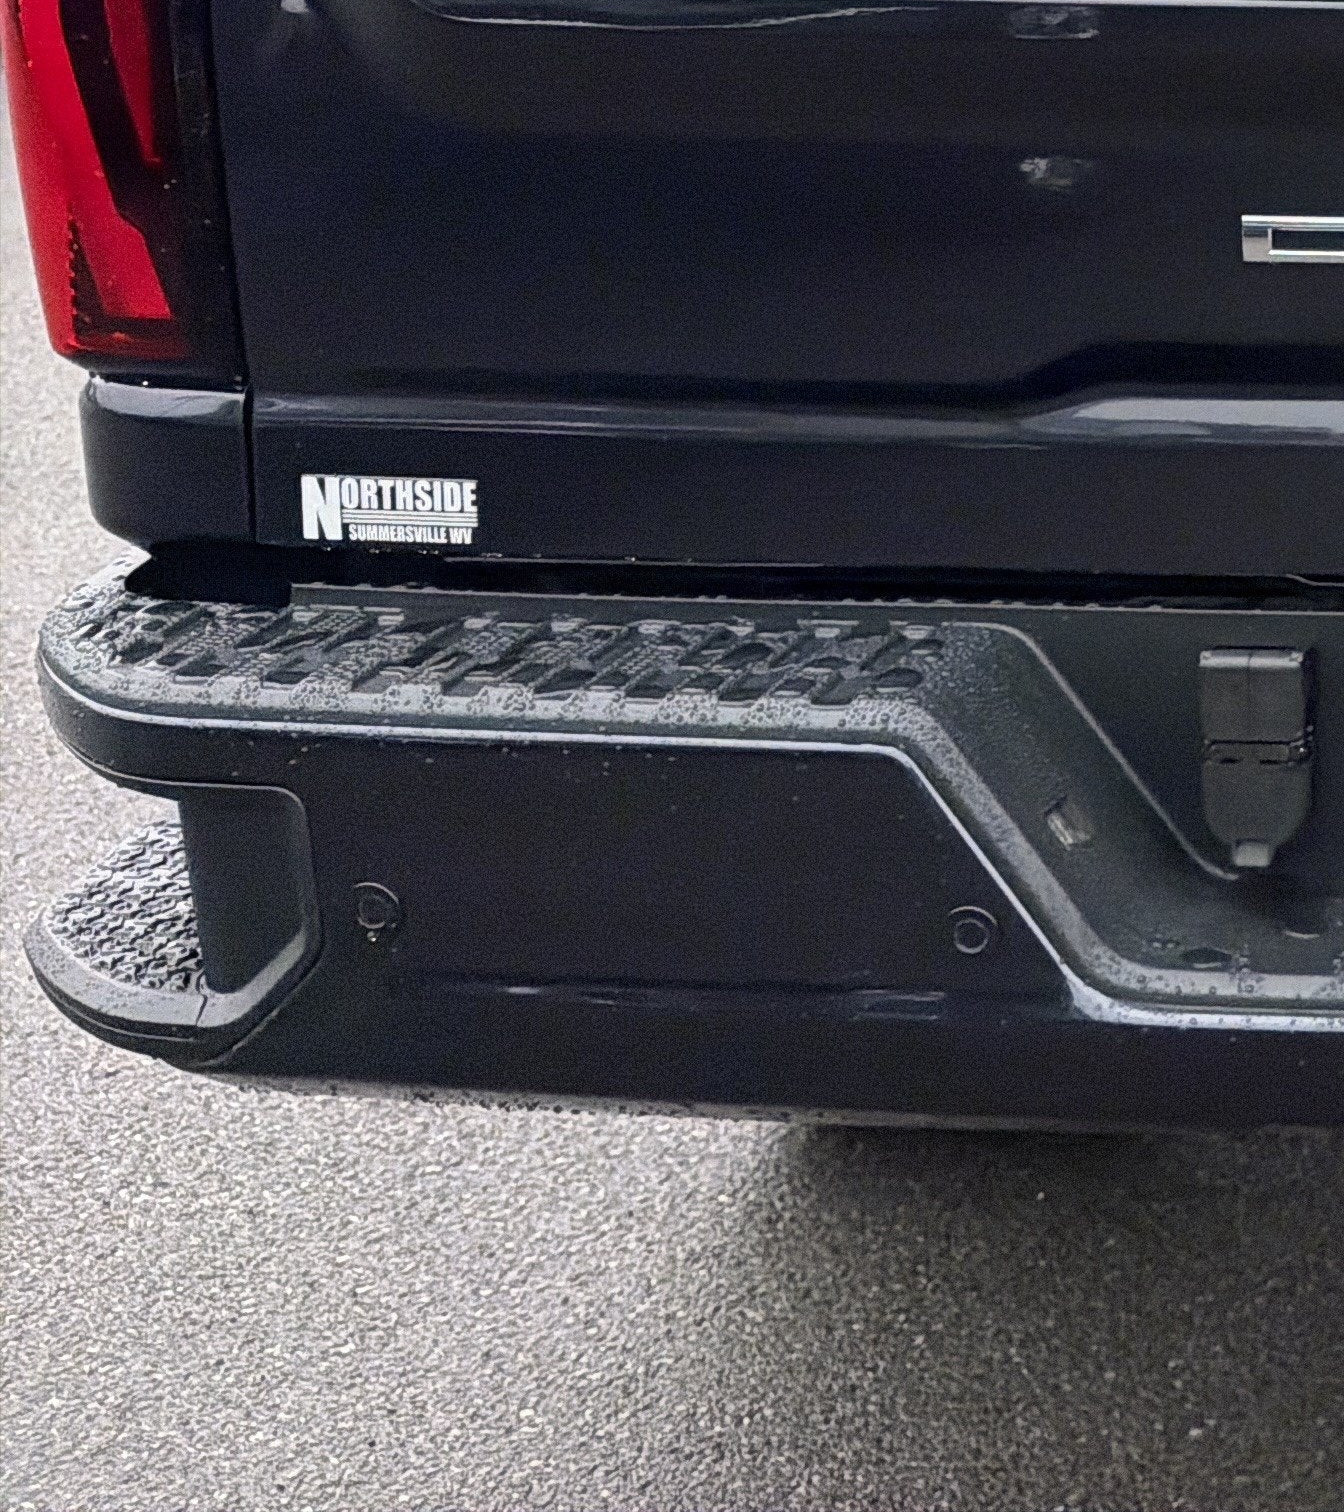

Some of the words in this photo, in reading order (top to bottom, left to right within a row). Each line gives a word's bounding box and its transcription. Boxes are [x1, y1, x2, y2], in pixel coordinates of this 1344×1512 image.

[301, 474, 478, 541] NORTHSIDE
[348, 524, 448, 544] SUMMERSVILLE
[449, 527, 473, 544] WV
